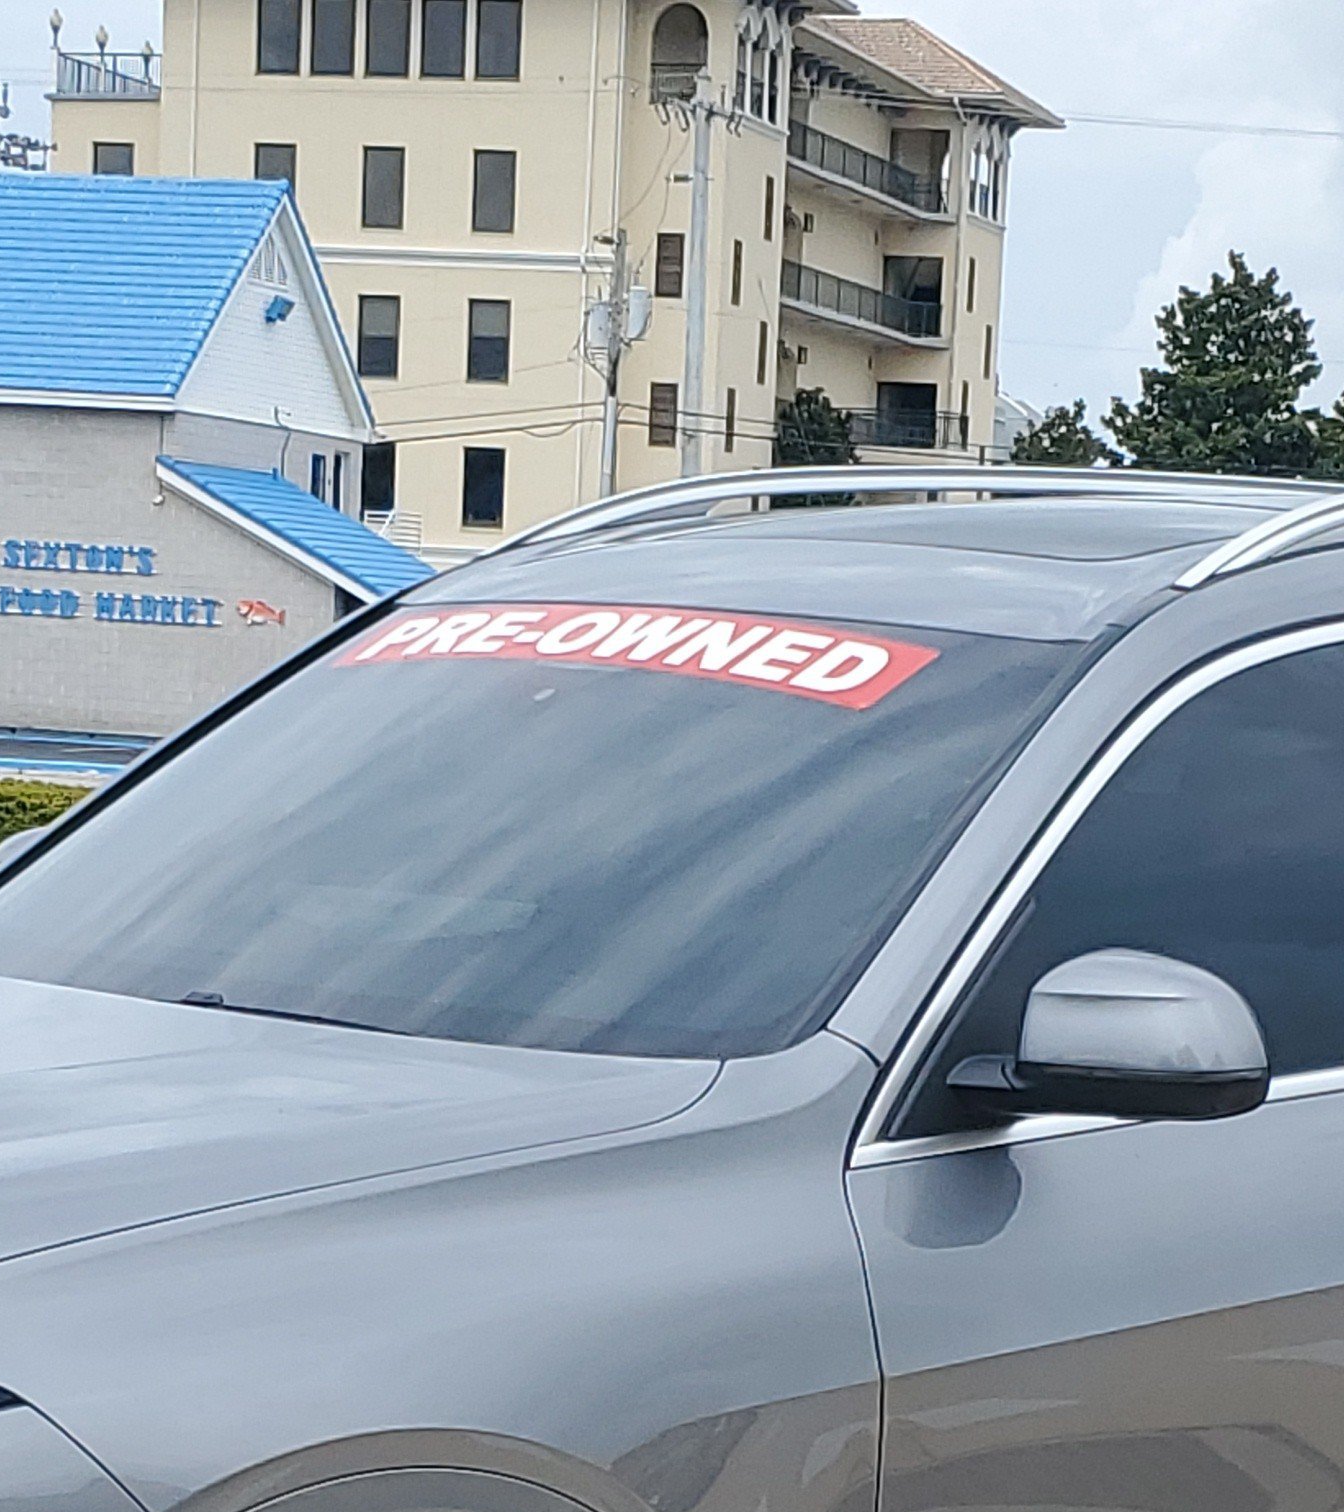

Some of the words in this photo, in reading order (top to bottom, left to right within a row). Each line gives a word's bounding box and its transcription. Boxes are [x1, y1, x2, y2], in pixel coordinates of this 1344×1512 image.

[2, 539, 159, 576] SEXTON'S
[93, 591, 225, 626] MARKET
[357, 611, 892, 692] PRE-OWNED
